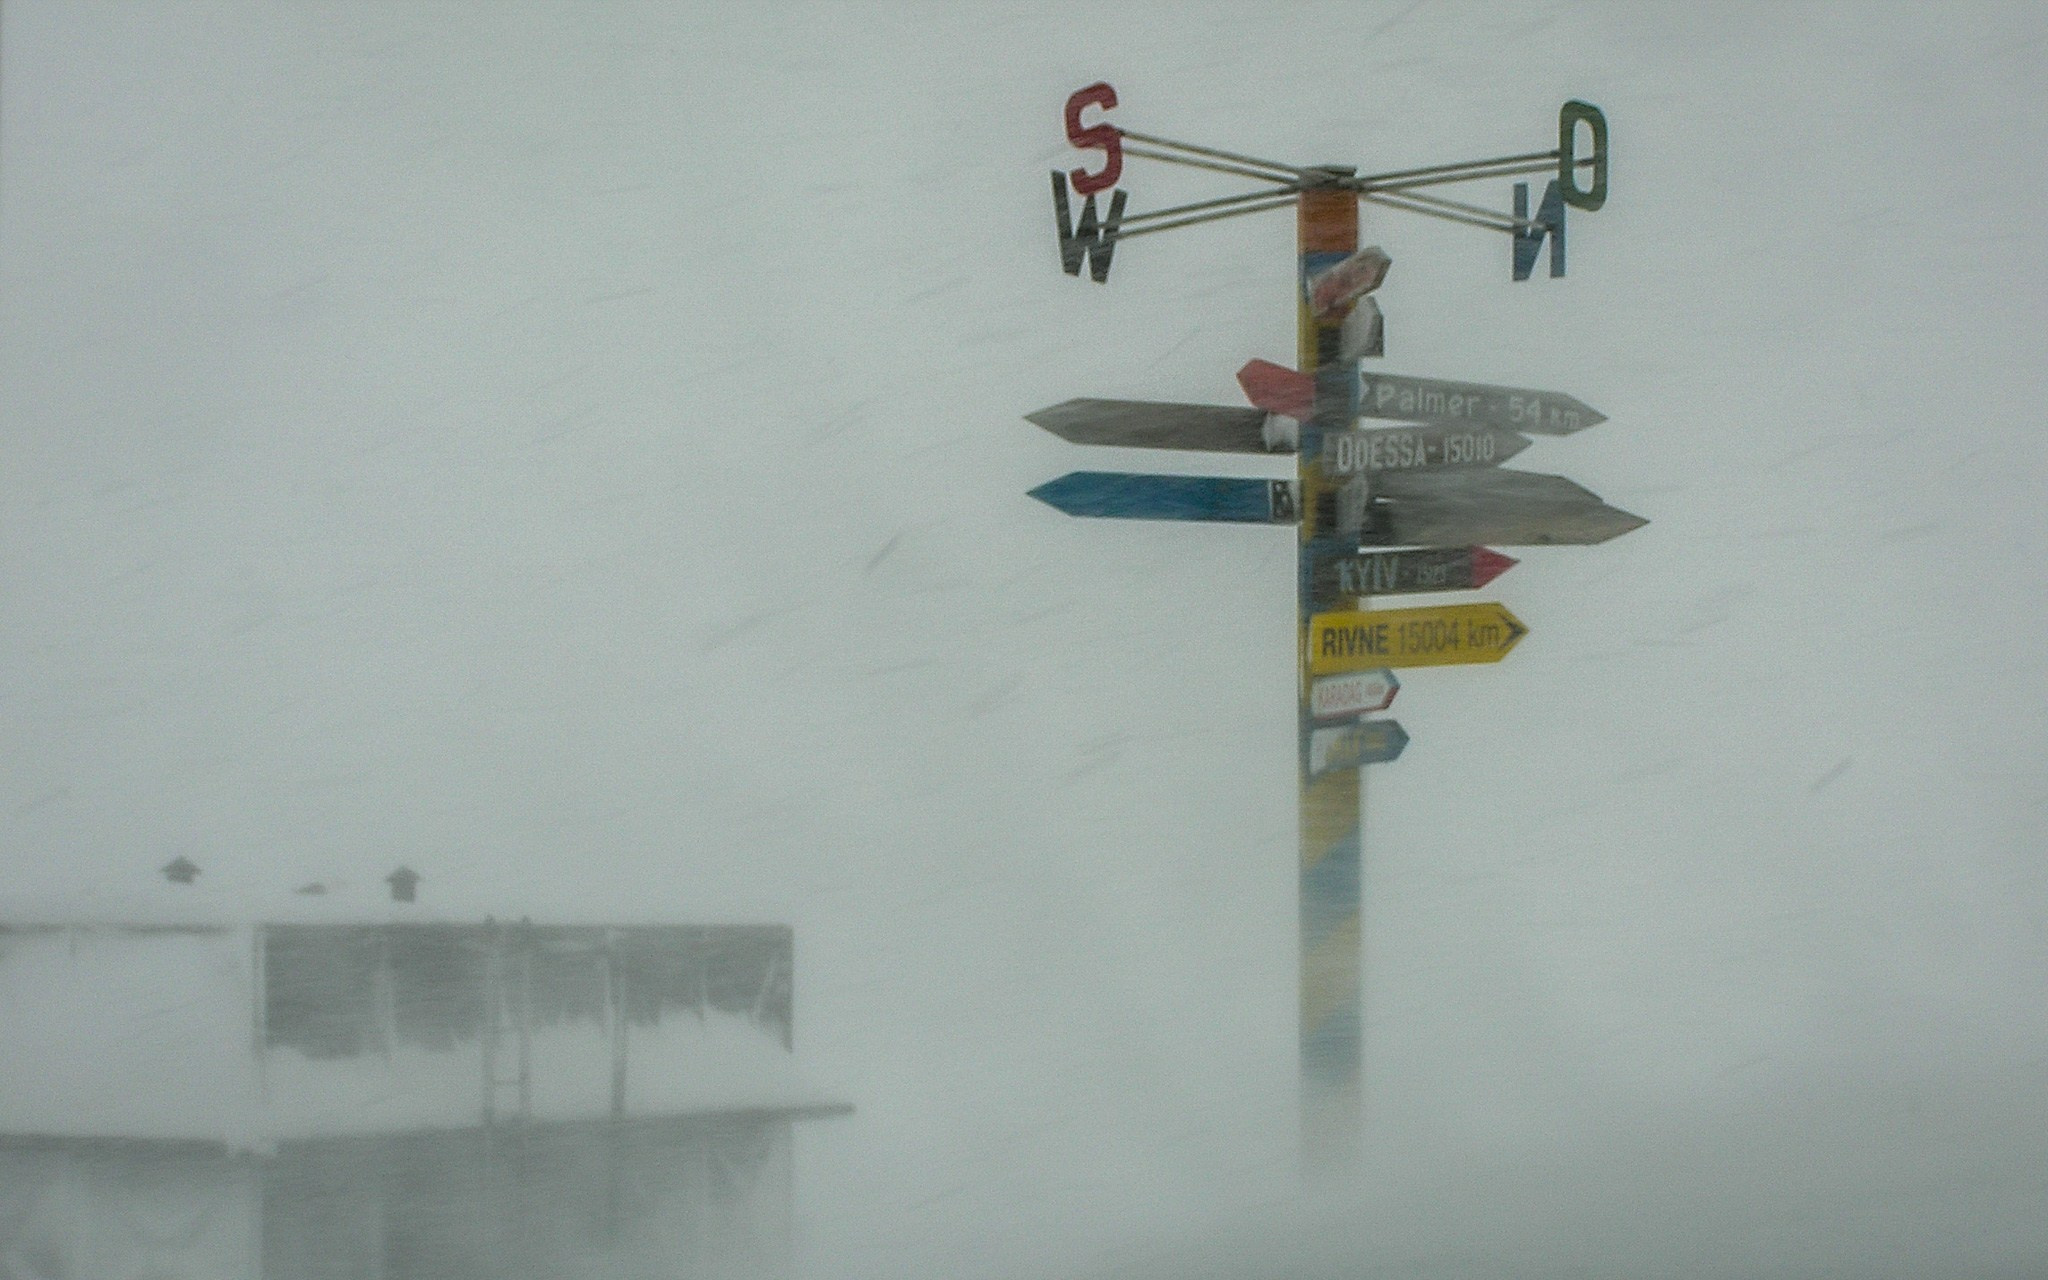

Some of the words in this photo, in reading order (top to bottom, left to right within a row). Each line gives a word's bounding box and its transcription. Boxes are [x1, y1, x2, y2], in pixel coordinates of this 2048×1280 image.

[1065, 81, 1125, 195] S
[1051, 170, 1128, 284] W
[1376, 383, 1480, 417] Palmer
[1508, 396, 1542, 425] 54
[1337, 554, 1399, 591] KYIV
[1322, 624, 1389, 657] RIVNE
[1398, 619, 1460, 652] 15004
[1467, 618, 1500, 648] km
